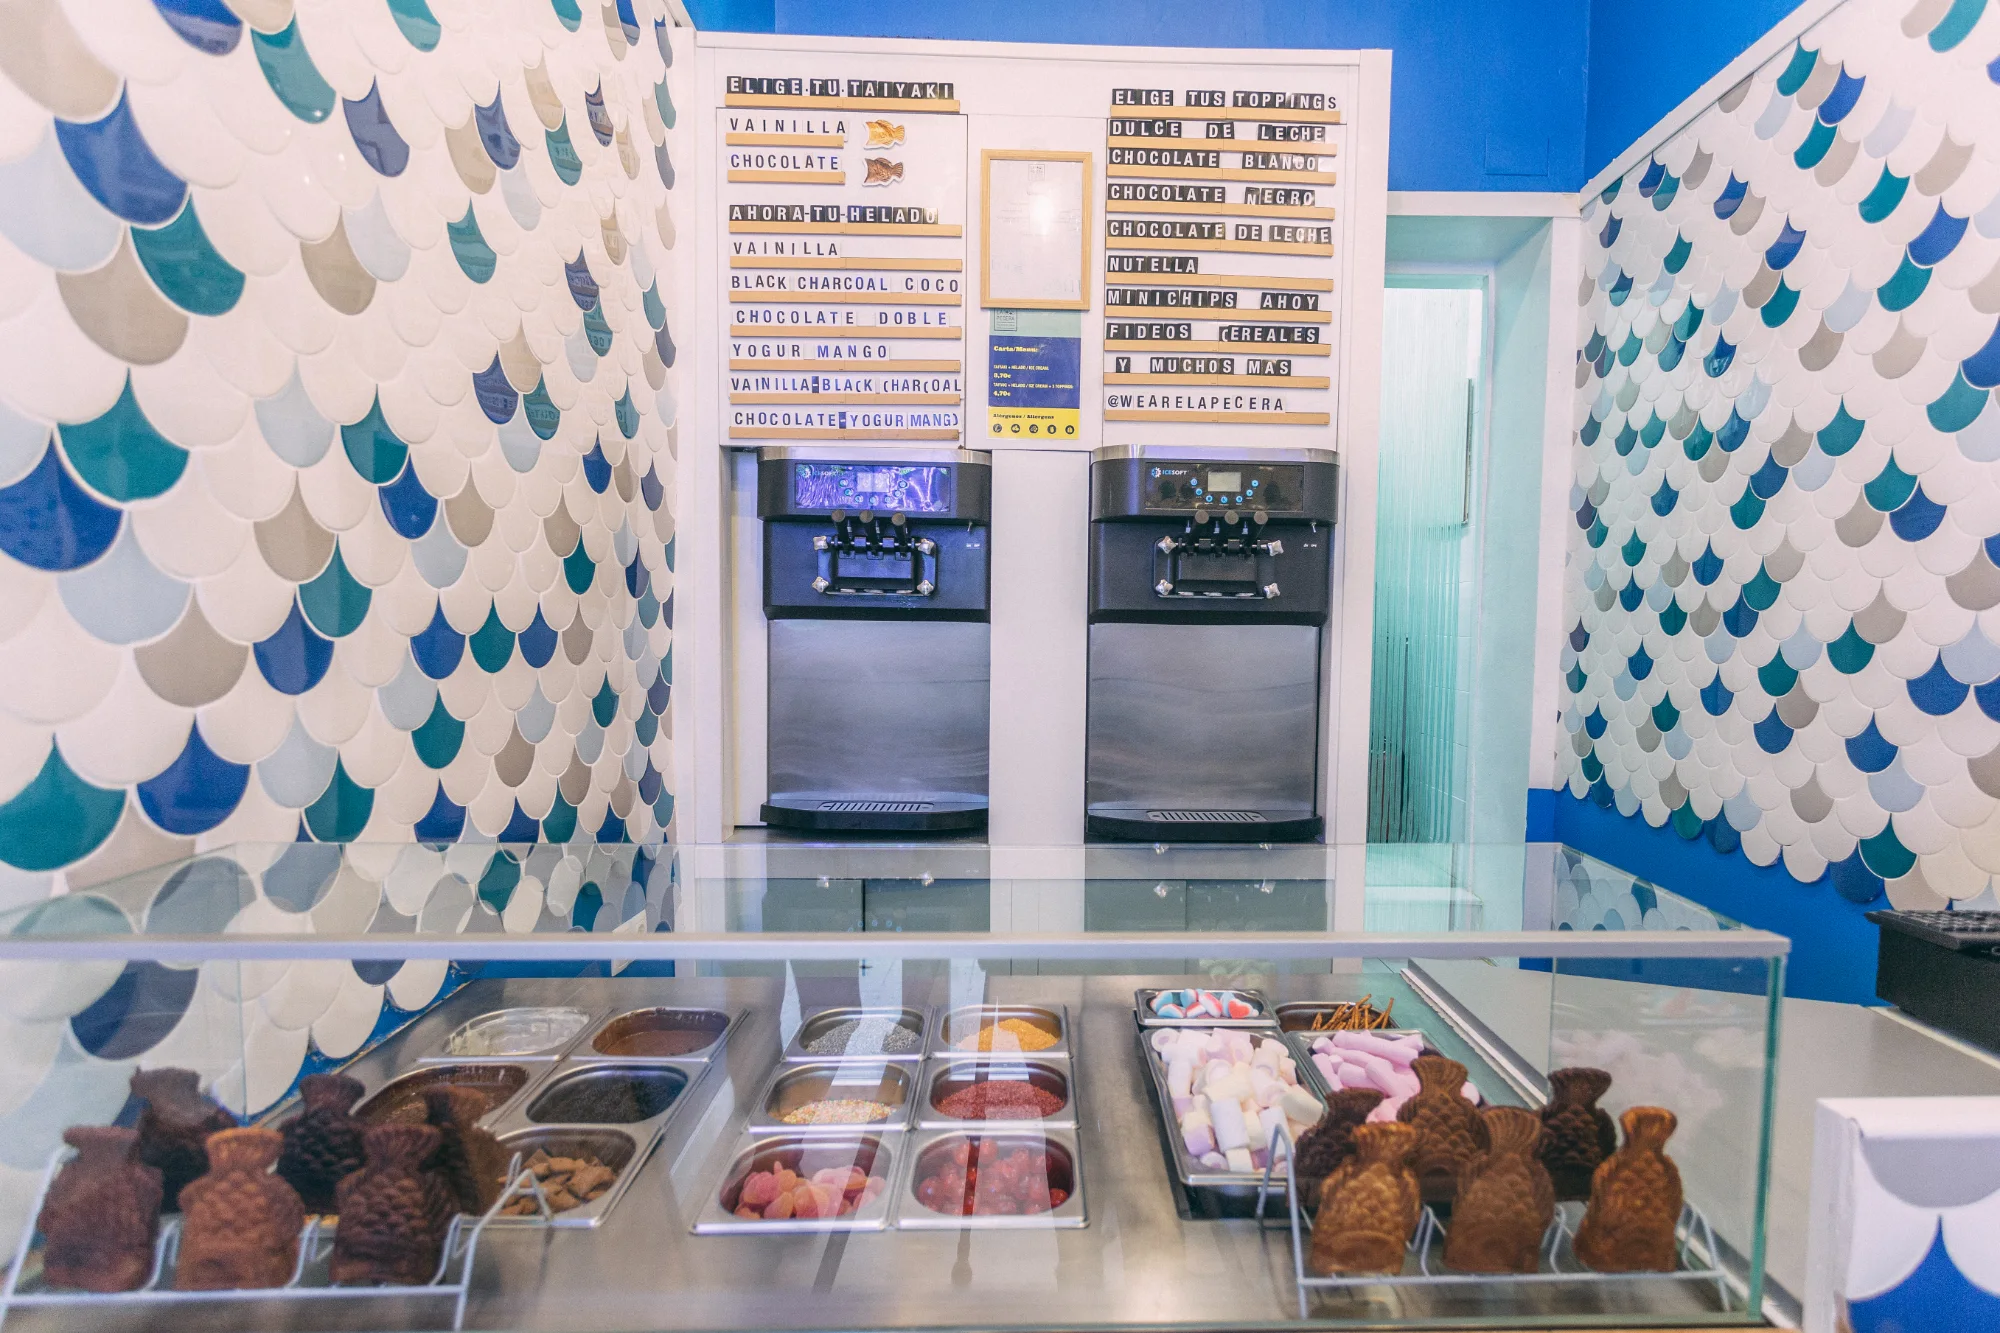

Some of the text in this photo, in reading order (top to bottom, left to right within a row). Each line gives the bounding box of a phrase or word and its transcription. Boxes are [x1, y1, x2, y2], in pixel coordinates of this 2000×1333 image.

[1115, 89, 1337, 110] ELIGE TUS TOPPINGS
[730, 117, 846, 134] VAINILLA
[1112, 120, 1324, 141] DULCE DE LECHE
[730, 153, 840, 170] CHOCOLATE
[1111, 148, 1317, 171] CHOCOLATE BLANCO
[1110, 185, 1314, 206] CHOCOLATE NEGRO
[1109, 221, 1330, 243] CHOCOLATE DE LECHE
[733, 241, 838, 257] VAINILLA
[1109, 257, 1196, 273] NUTELLA
[731, 274, 959, 293] BLACK CHARCOAL COCO
[1107, 289, 1317, 310] MINICHIPS AHOY
[735, 309, 947, 326] CHOCOLATE DOBLE
[1109, 324, 1317, 343] FIDEOS CEREALES
[732, 343, 888, 359] YOGUR MANGO
[1118, 358, 1289, 375] Y MUCHOS MAS
[882, 378, 962, 394] CHARCOAL
[1107, 394, 1283, 411] @WEARELAPECERA
